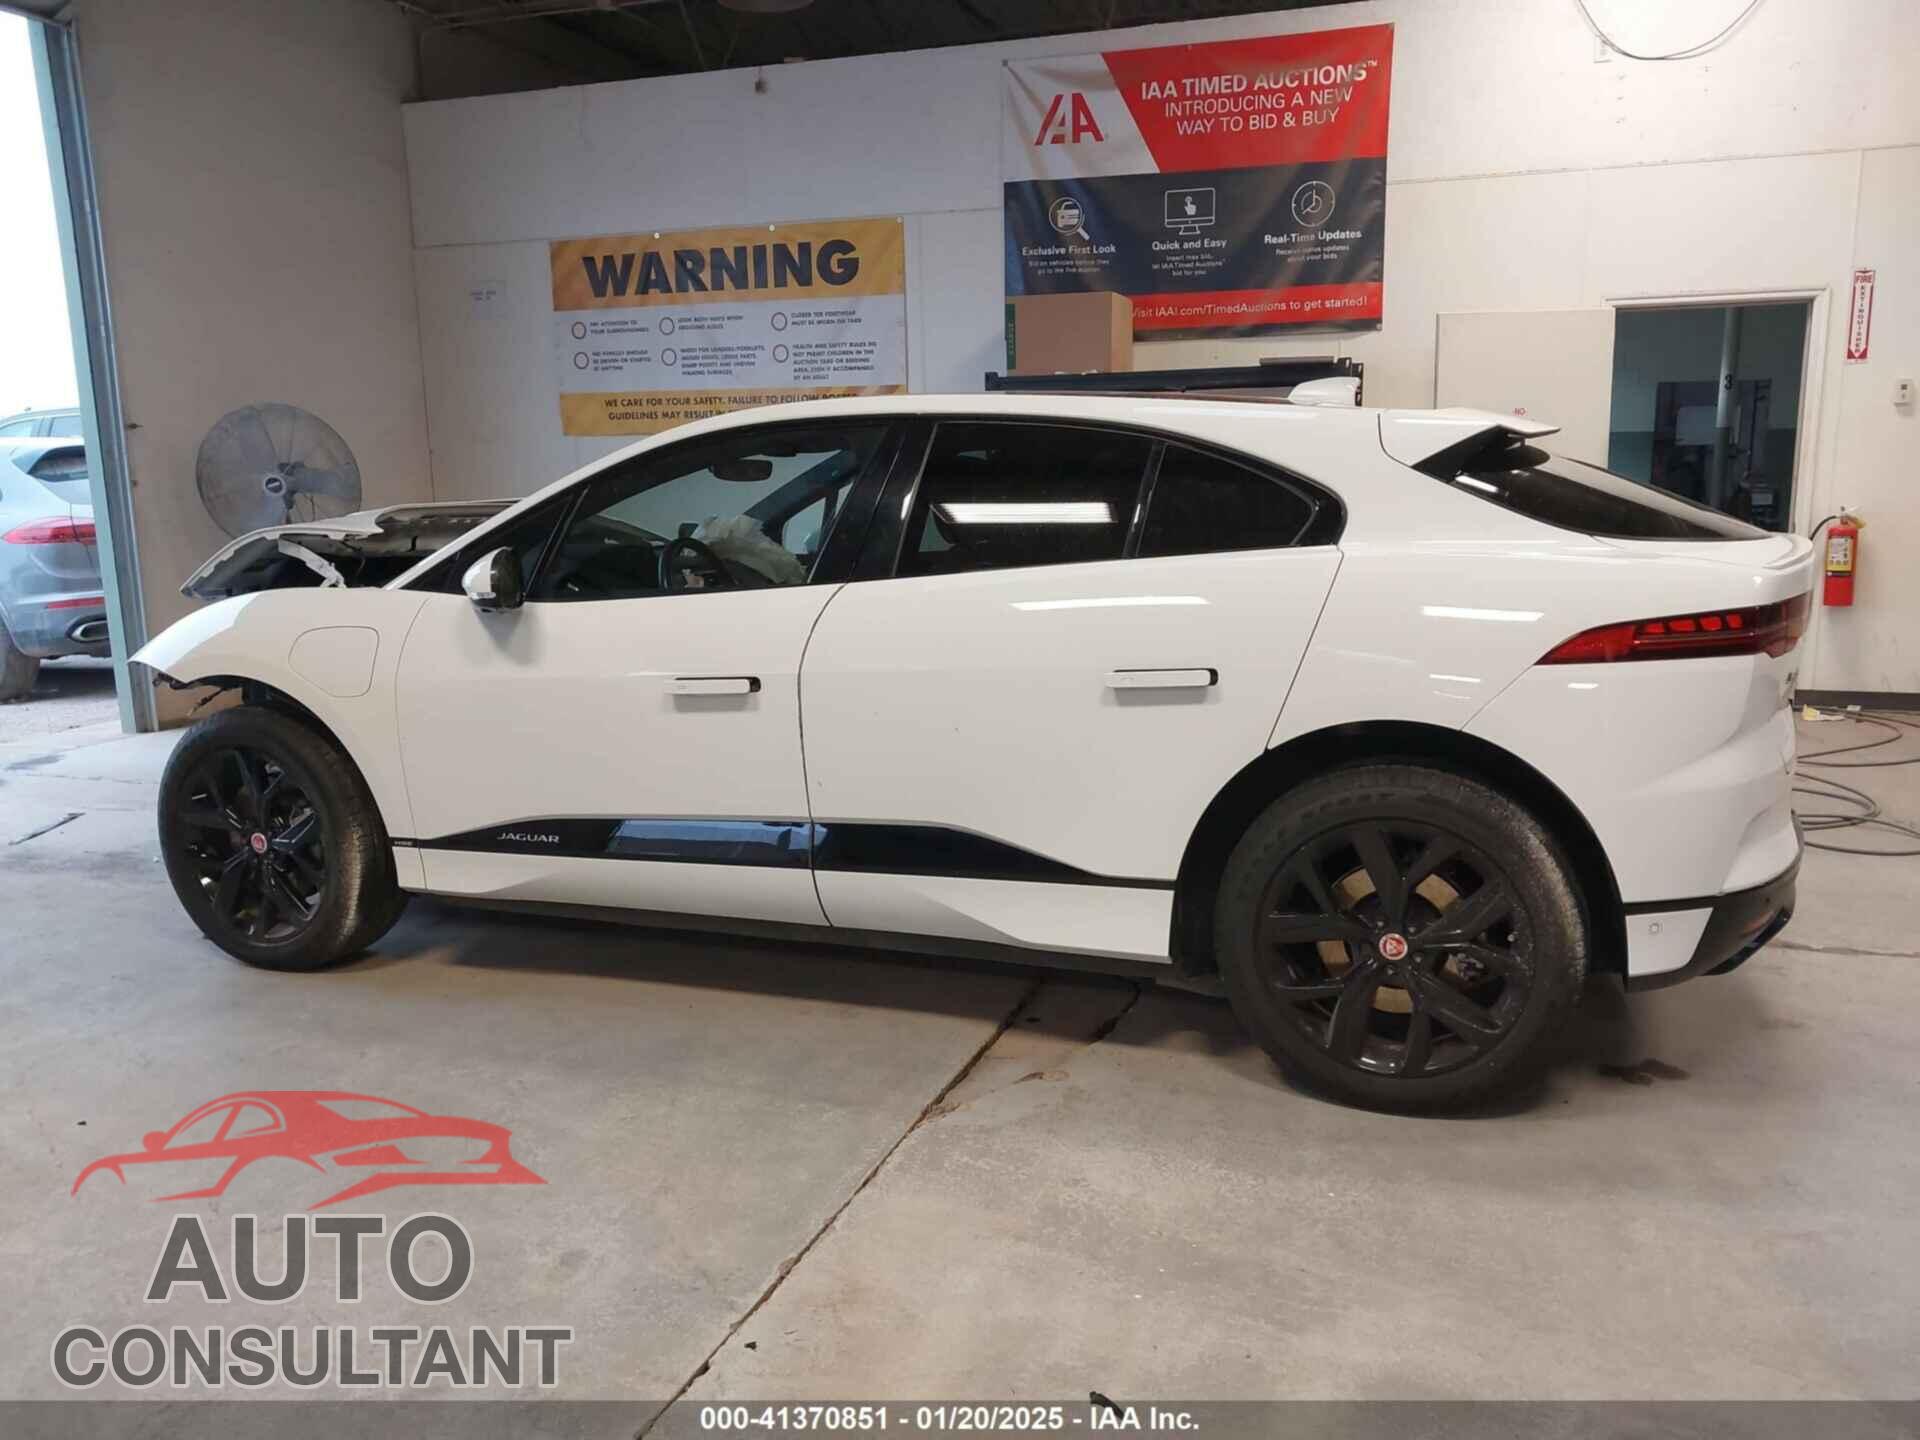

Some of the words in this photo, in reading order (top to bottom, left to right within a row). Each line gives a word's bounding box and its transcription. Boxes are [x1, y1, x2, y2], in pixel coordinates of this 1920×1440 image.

[1141, 80, 1178, 100] IAA
[1182, 74, 1248, 97] TIMED
[1165, 93, 1286, 118] INTRODUCING
[1291, 93, 1304, 107] A
[1310, 86, 1353, 105] NEW
[1176, 118, 1216, 136] WAY
[1219, 116, 1244, 132] TO
[1249, 113, 1278, 130] BID
[1282, 112, 1296, 128] &
[1302, 107, 1340, 127] BUY
[1264, 233, 1316, 244] Real-Time
[1318, 230, 1363, 242] Updates
[1022, 245, 1067, 256] Exclusive
[1068, 244, 1091, 255] First
[1092, 243, 1117, 254] Look
[1152, 240, 1180, 251] Quick
[1183, 239, 1202, 249] and
[1204, 238, 1228, 249] Easy
[582, 239, 860, 298] WARNING
[1855, 274, 1873, 284] FIRE
[1289, 300, 1301, 311] to
[1304, 300, 1322, 312] get
[1325, 296, 1368, 308] started!
[605, 398, 618, 407] WE
[620, 398, 643, 407] CARE
[646, 397, 663, 406] FOR
[665, 396, 691, 406] YOUR
[765, 394, 779, 404] TO
[608, 411, 658, 421] GUIDELINES
[662, 410, 681, 420] MAY
[497, 832, 561, 844] JAGUAR
